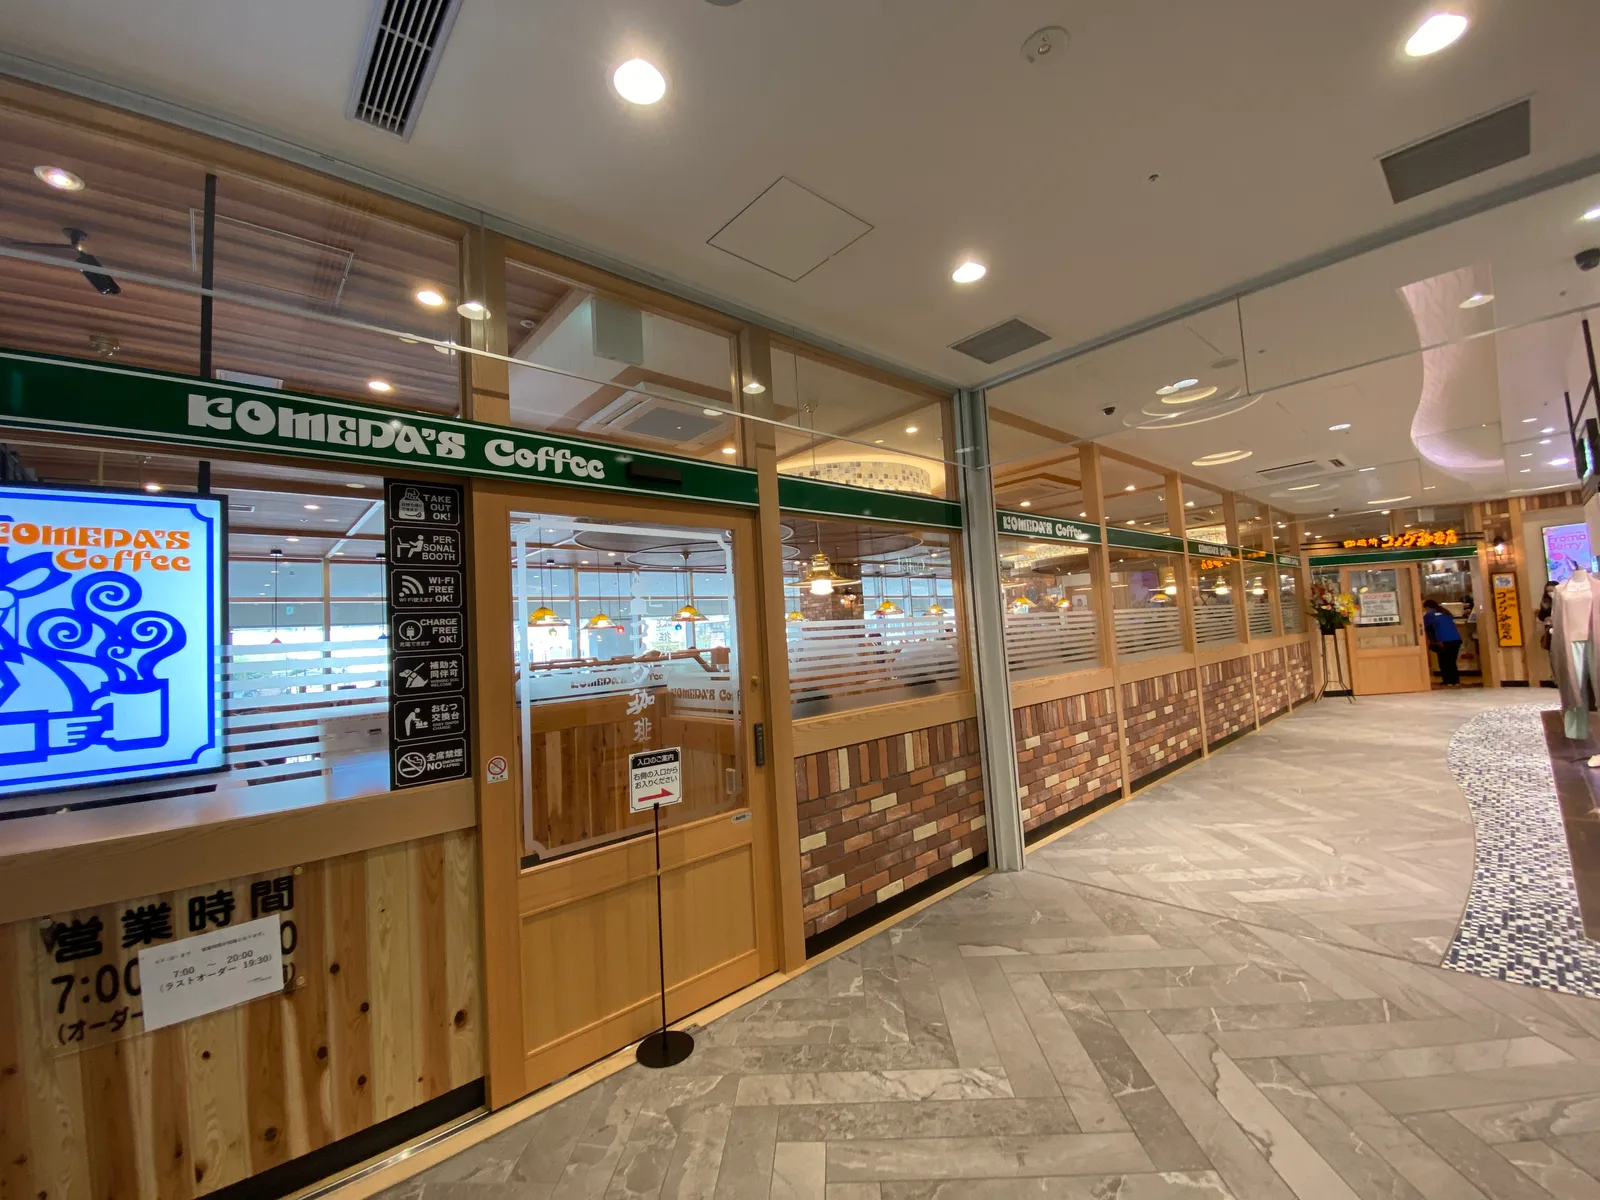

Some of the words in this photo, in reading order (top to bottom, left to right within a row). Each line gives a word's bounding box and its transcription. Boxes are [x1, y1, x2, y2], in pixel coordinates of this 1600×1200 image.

[187, 393, 466, 460] KOMEDA'S
[484, 438, 606, 480] Coffee
[423, 494, 452, 504] TAKE
[430, 503, 452, 512] OUT
[432, 512, 451, 521] OK!
[1003, 516, 1052, 535] KOMEDA'S
[433, 535, 456, 544] PER-
[423, 543, 456, 553] SONAL
[55, 548, 191, 572] Coffee
[422, 552, 456, 561] BOOTH
[428, 576, 455, 584] WI-FI
[428, 585, 455, 593] FREE
[435, 594, 453, 603] OK!
[420, 618, 458, 626] CHARGE
[432, 626, 458, 635] FREE
[438, 634, 457, 643] OK!
[429, 660, 458, 670] 補助犬
[430, 668, 459, 679] 同伴可
[431, 703, 458, 713] おむつ
[431, 711, 460, 723] 交換台
[426, 748, 463, 762] 全席禁煙
[637, 754, 675, 766] 入口のご案内
[427, 761, 443, 771] NO
[634, 767, 678, 781] 右側の入口から
[635, 775, 678, 790] お入りください
[55, 875, 295, 963] 営業時間
[173, 966, 195, 979] 7:00
[227, 949, 254, 964] 20:00
